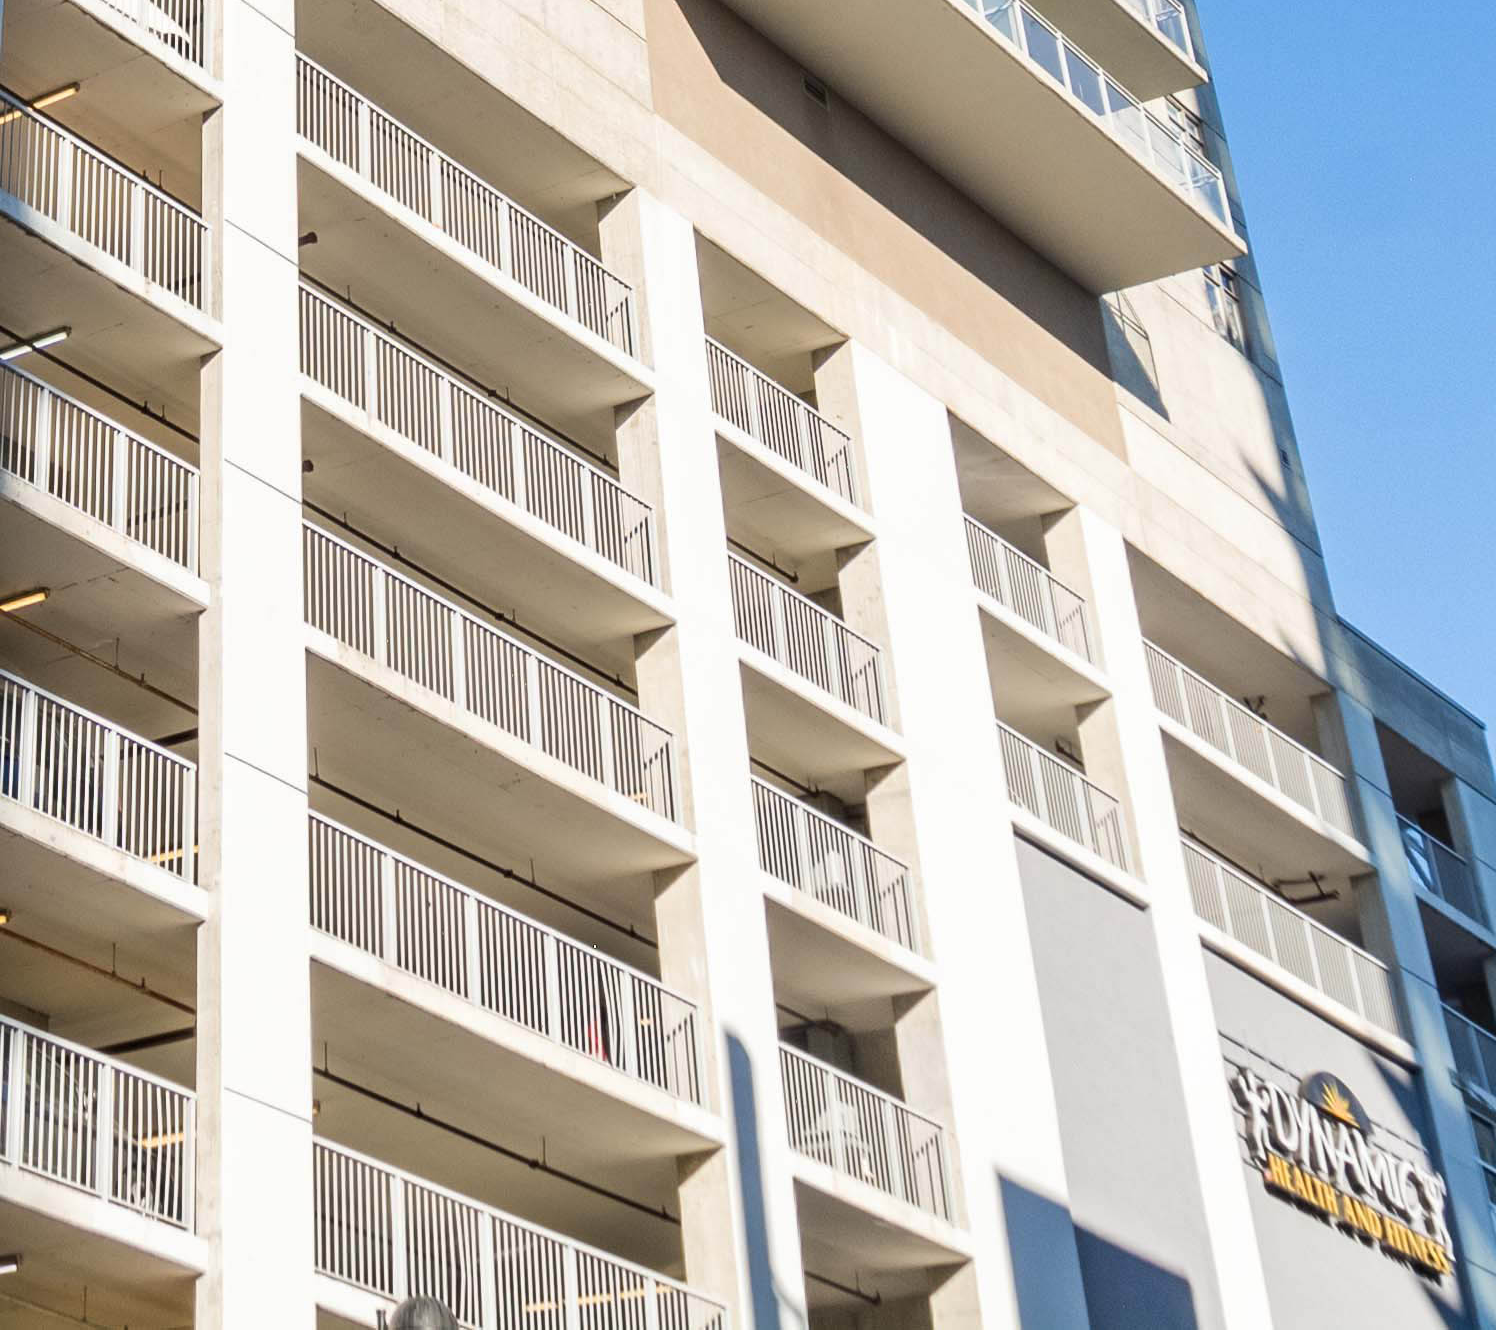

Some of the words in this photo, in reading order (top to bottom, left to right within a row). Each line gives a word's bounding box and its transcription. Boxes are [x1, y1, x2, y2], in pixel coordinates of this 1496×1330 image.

[1267, 1152, 1340, 1216] HEALTH
[1343, 1196, 1384, 1239] AND
[1383, 1216, 1452, 1276] FITNESS
